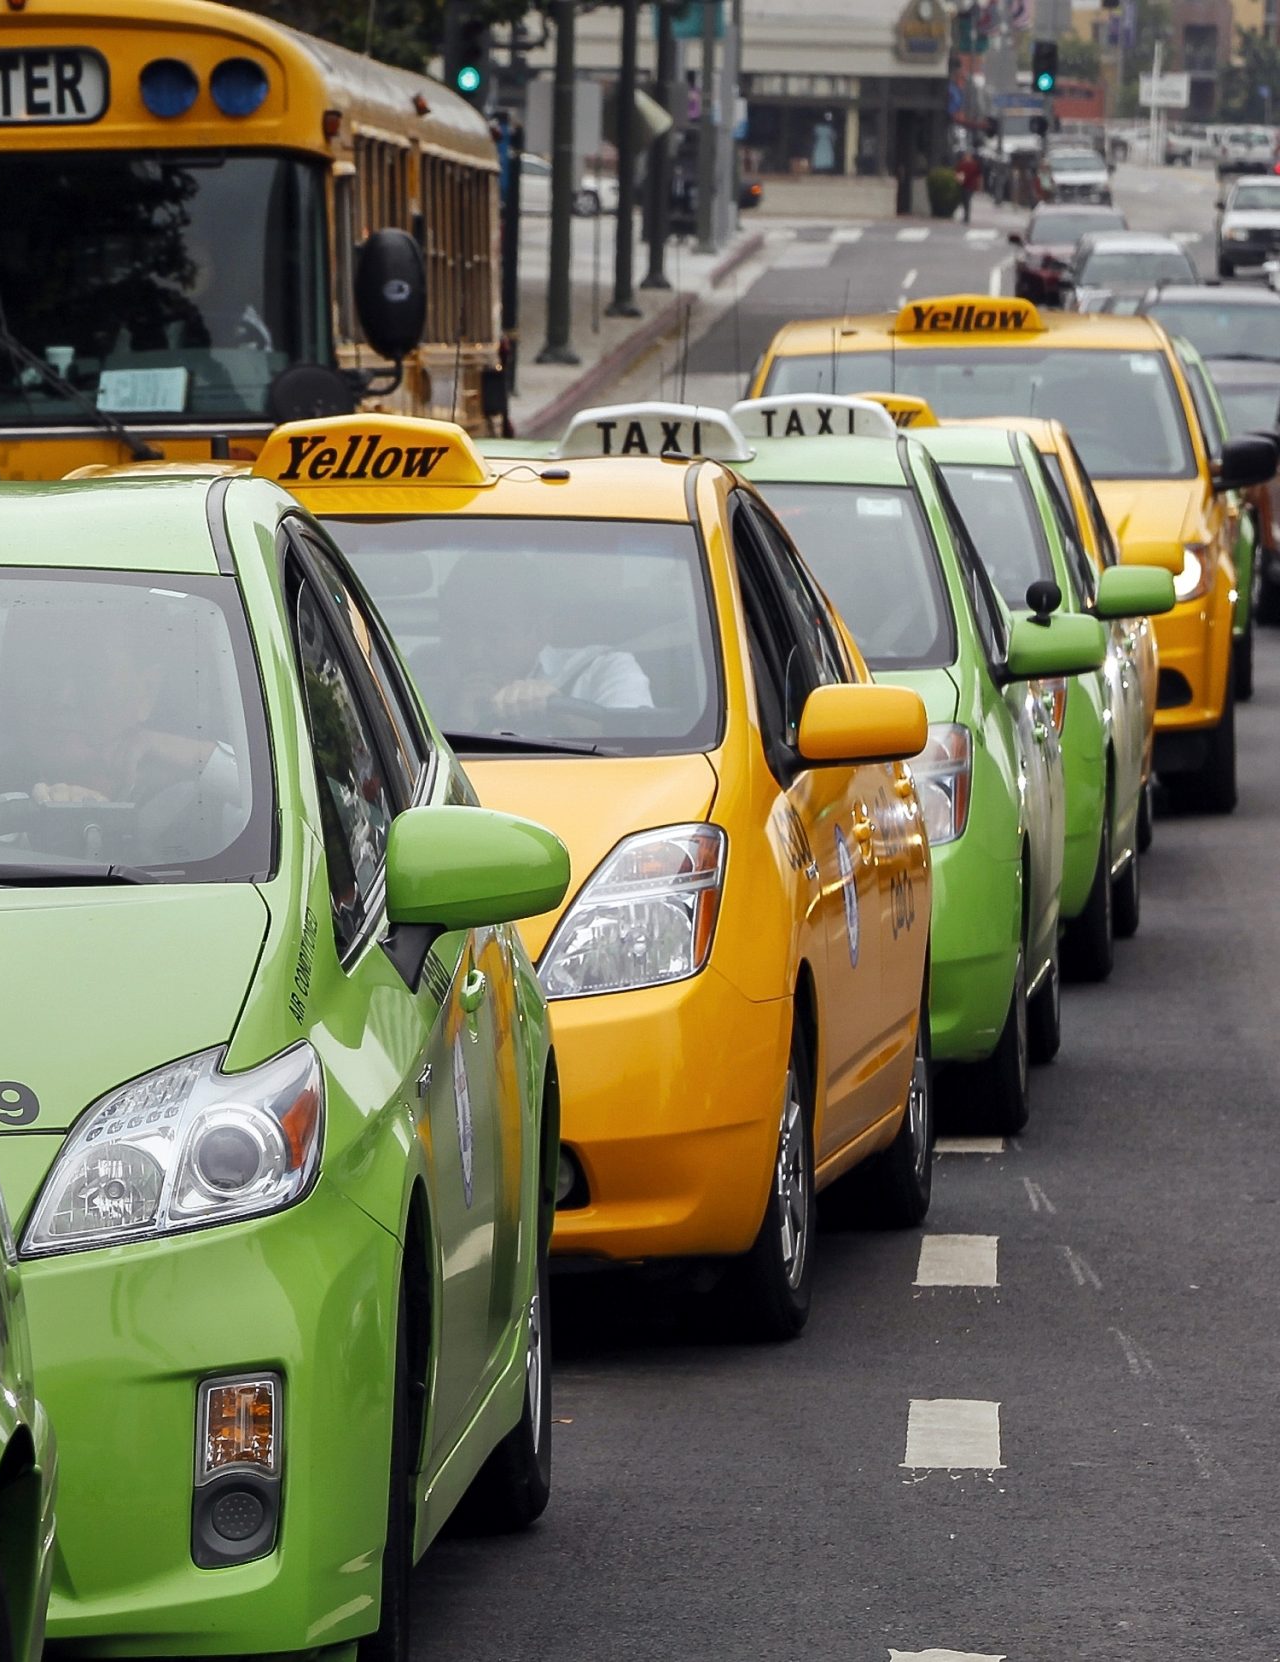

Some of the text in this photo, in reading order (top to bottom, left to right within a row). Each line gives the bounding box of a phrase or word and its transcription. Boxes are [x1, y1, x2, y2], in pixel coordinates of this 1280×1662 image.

[913, 305, 1030, 332] Yellow
[596, 420, 702, 456] TAXI
[760, 407, 856, 438] TAXI
[277, 434, 450, 481] Yellow
[288, 905, 319, 1026] AIR CONDITIONED
